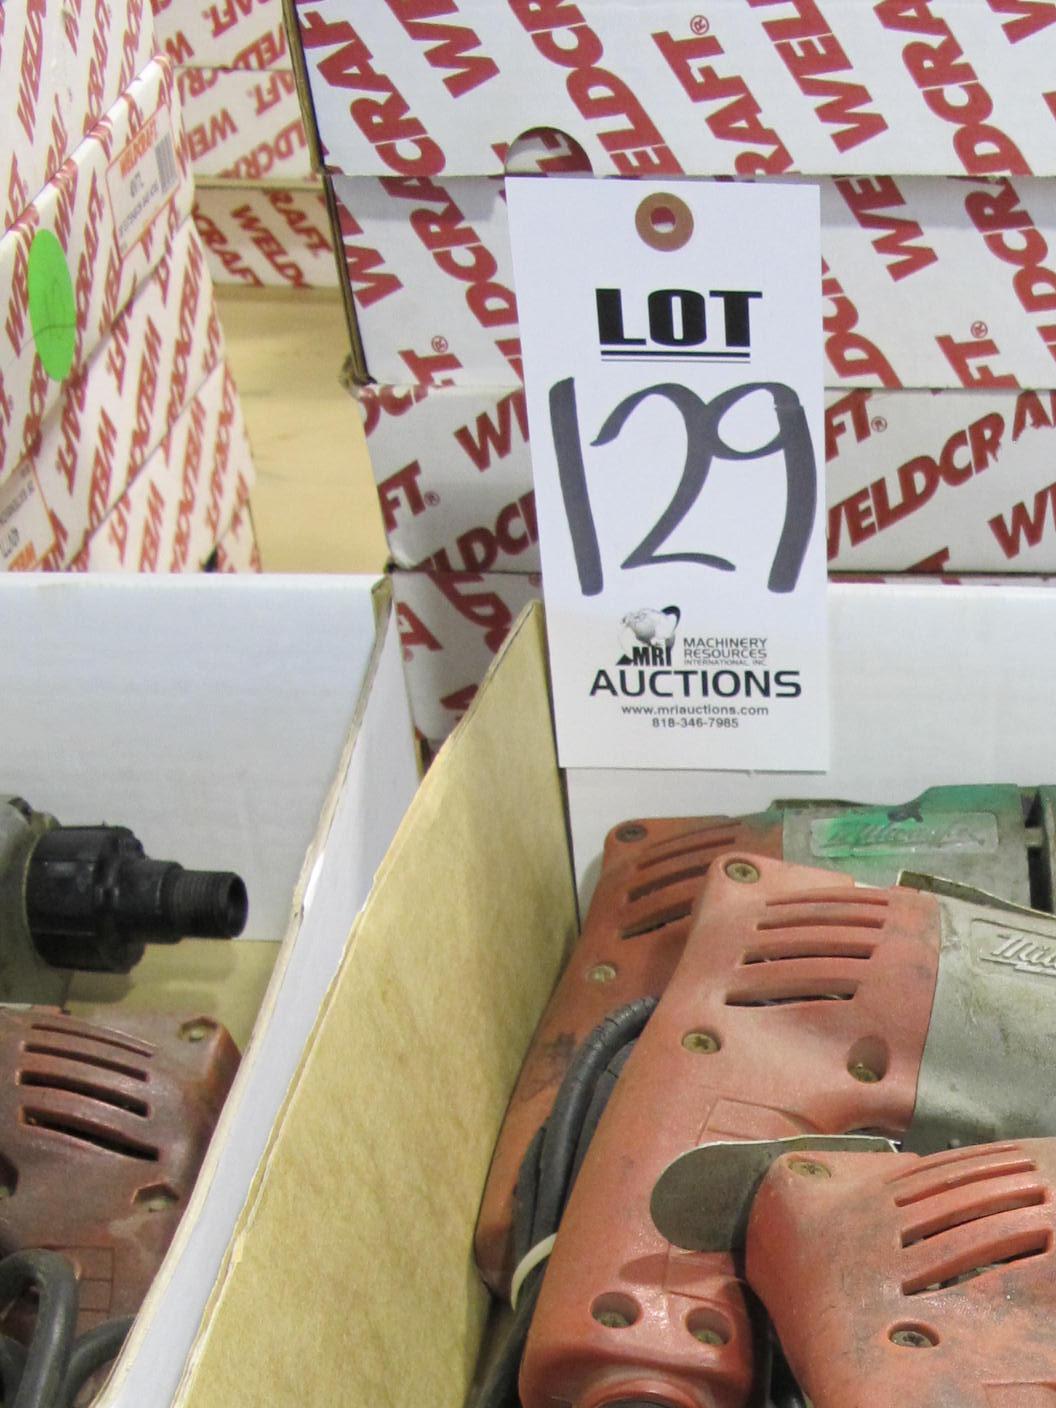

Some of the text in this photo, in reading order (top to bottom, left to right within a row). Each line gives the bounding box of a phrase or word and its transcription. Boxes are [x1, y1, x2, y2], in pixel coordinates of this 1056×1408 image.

[596, 288, 763, 348] LOT
[549, 376, 818, 597] 129
[683, 637, 767, 648] MACHINERY
[683, 648, 767, 659] RESOURCES
[589, 669, 802, 698] AUCTIONS
[621, 704, 769, 715] www.mriauctions.com
[652, 717, 739, 728] 818-346-7985
